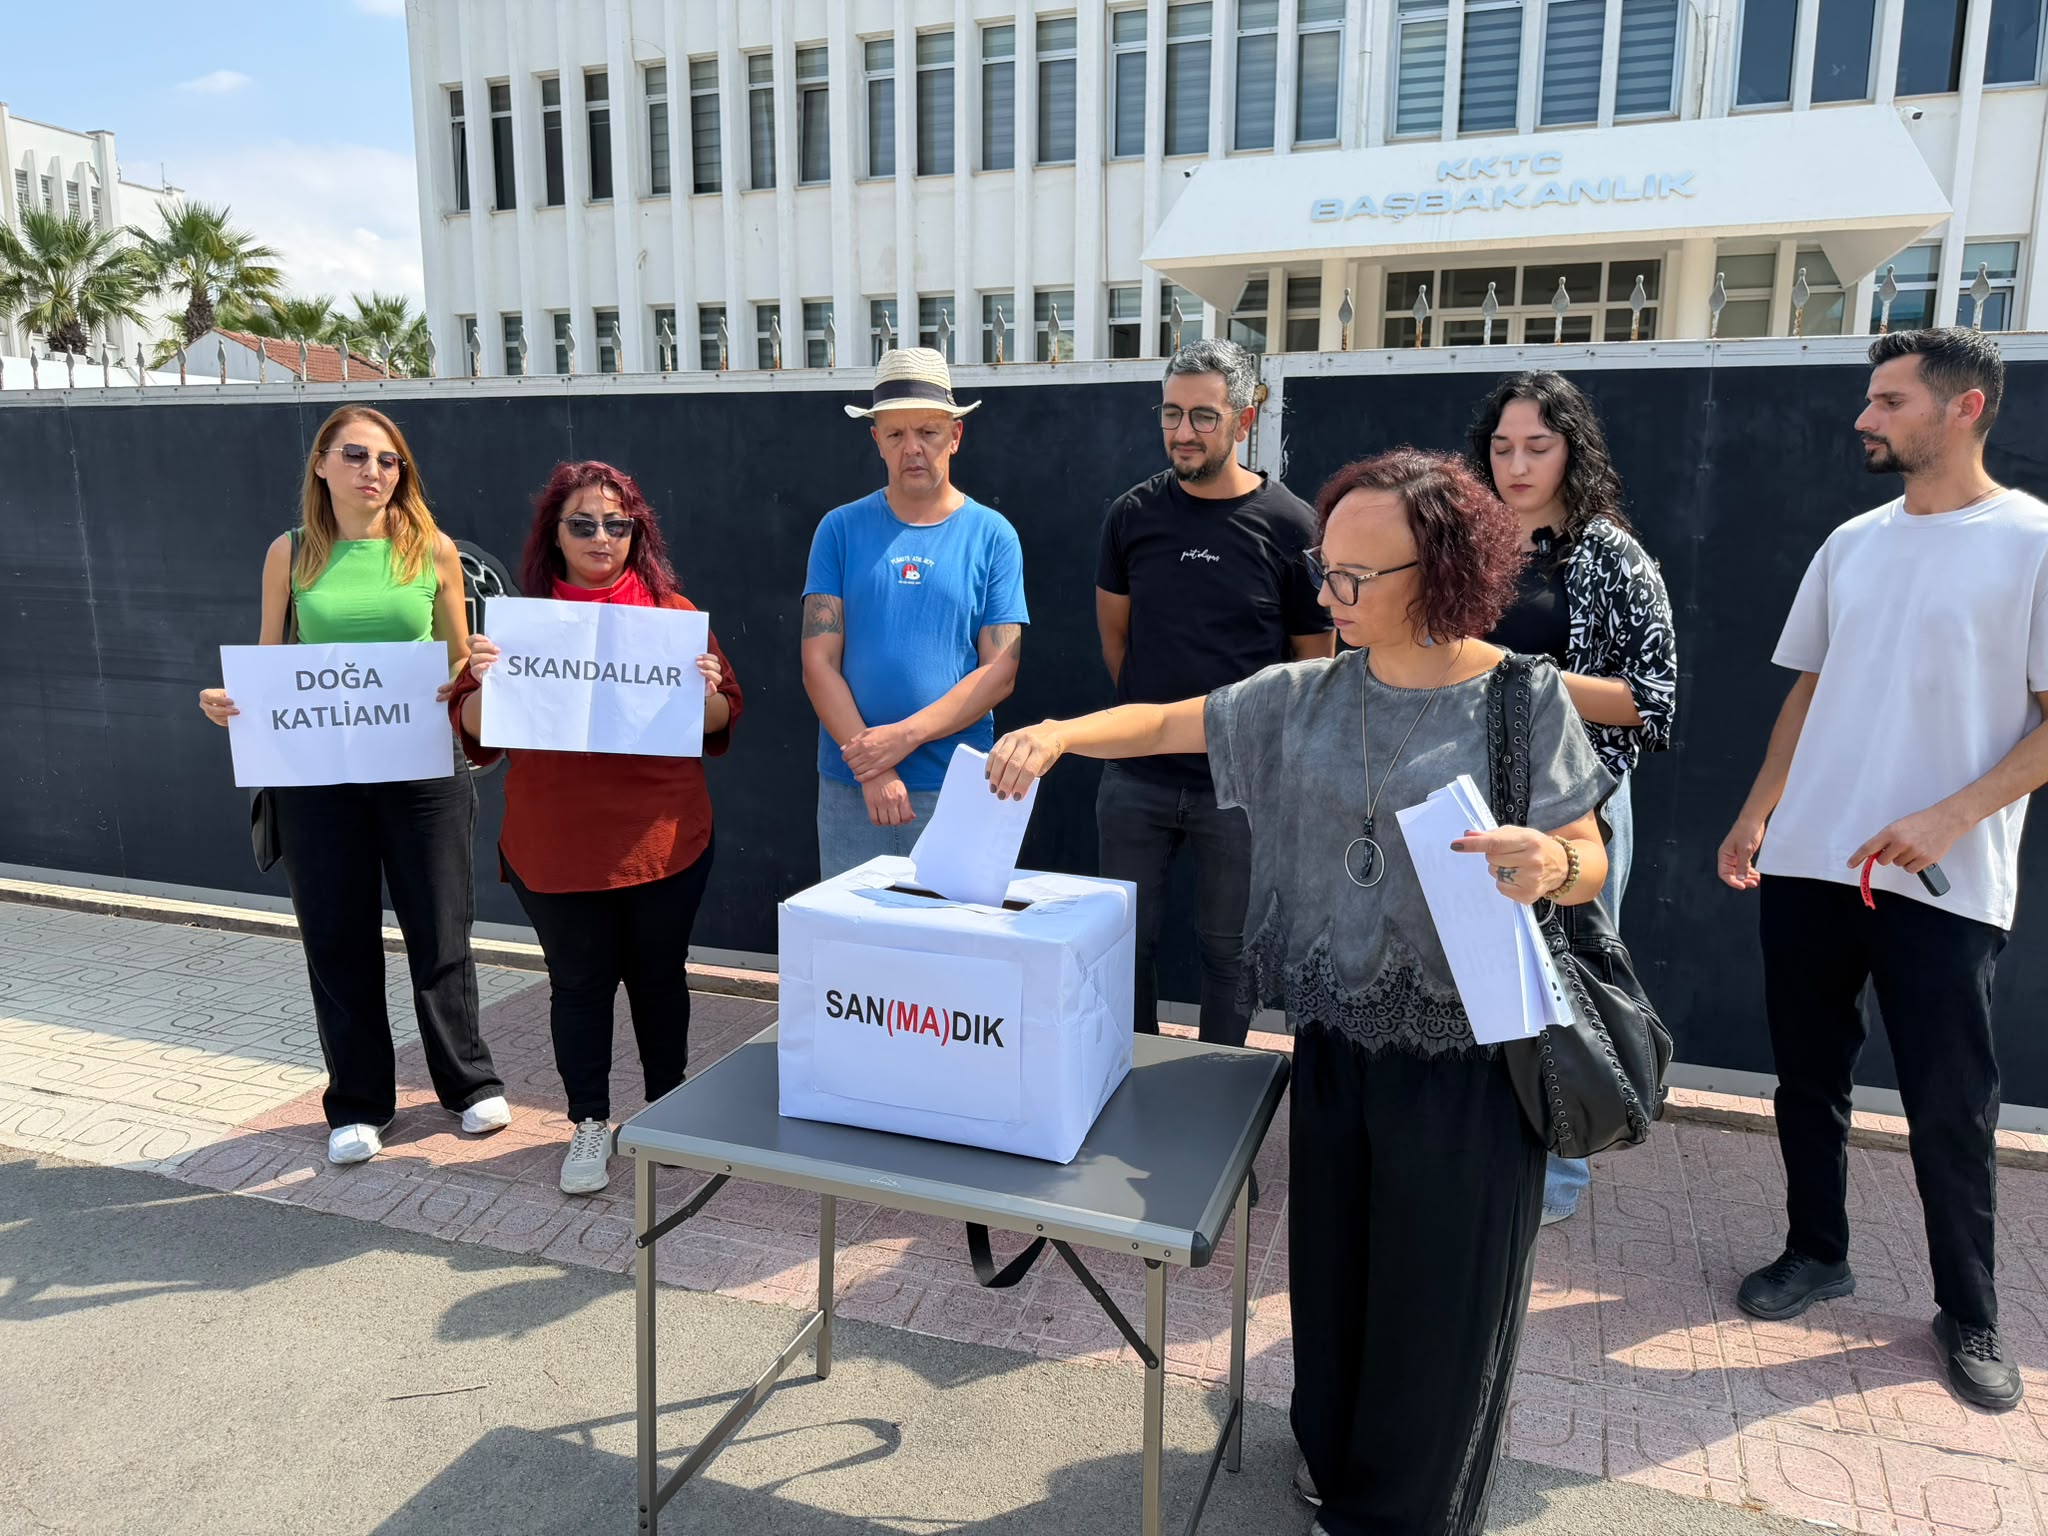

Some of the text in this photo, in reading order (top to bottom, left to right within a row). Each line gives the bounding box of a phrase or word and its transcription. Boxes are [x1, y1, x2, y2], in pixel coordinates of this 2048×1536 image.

[1437, 151, 1564, 181] KKTC
[1311, 171, 1696, 220] BAŞBAKANLIK
[296, 662, 384, 691] DOĞA
[507, 655, 682, 687] SKANDALLAR
[271, 700, 410, 731] KATLİAMI
[826, 989, 1004, 1048] SAN(MA)DIK
